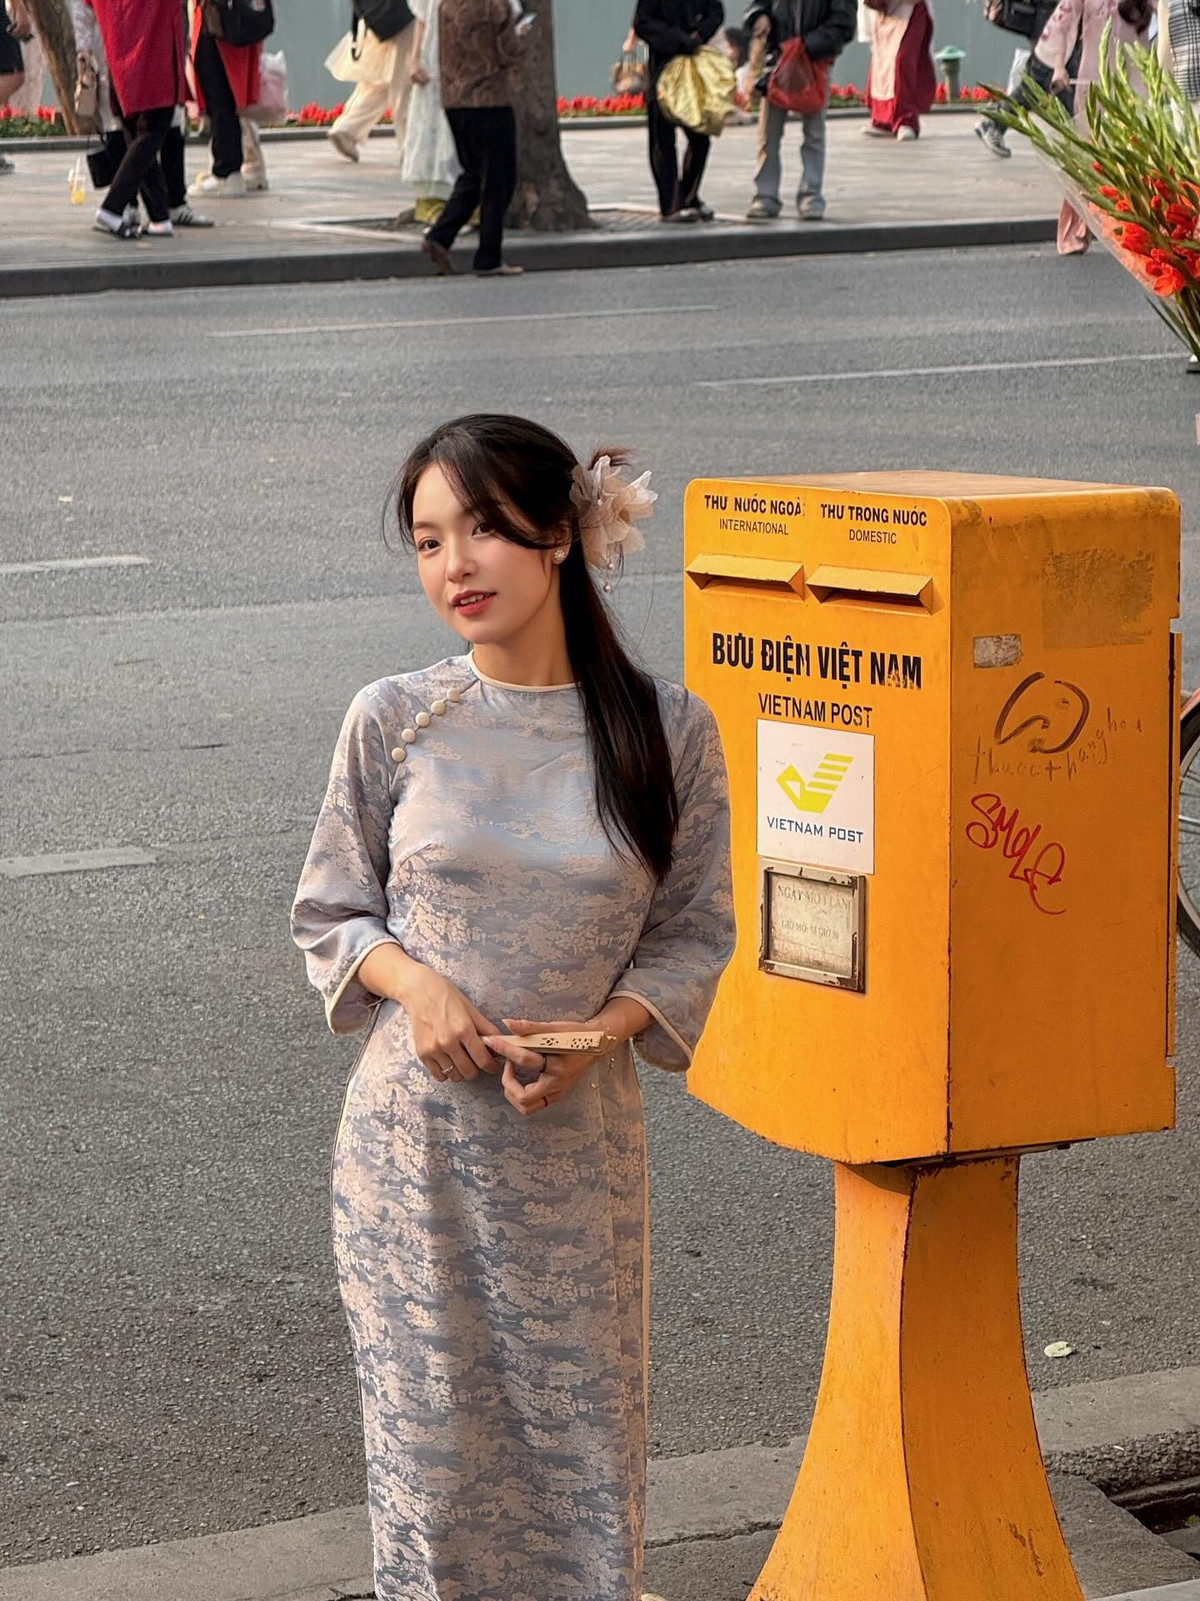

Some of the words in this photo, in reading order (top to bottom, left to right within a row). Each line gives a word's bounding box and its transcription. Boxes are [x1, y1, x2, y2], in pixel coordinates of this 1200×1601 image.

[770, 496, 805, 517] NGOÀ
[848, 505, 889, 524] TRONG
[893, 504, 927, 527] NƯỚC
[719, 518, 789, 536] INTERNATIONAL
[849, 528, 897, 545] DOMESTIC
[712, 632, 754, 670] BƯU
[760, 635, 810, 682] ĐIỆN
[817, 641, 863, 689] VIỆT
[870, 652, 922, 690] NAM
[758, 692, 826, 723] VIETNAM
[831, 702, 873, 728] POST
[766, 816, 823, 837] VIETNAM
[829, 826, 864, 843] POST
